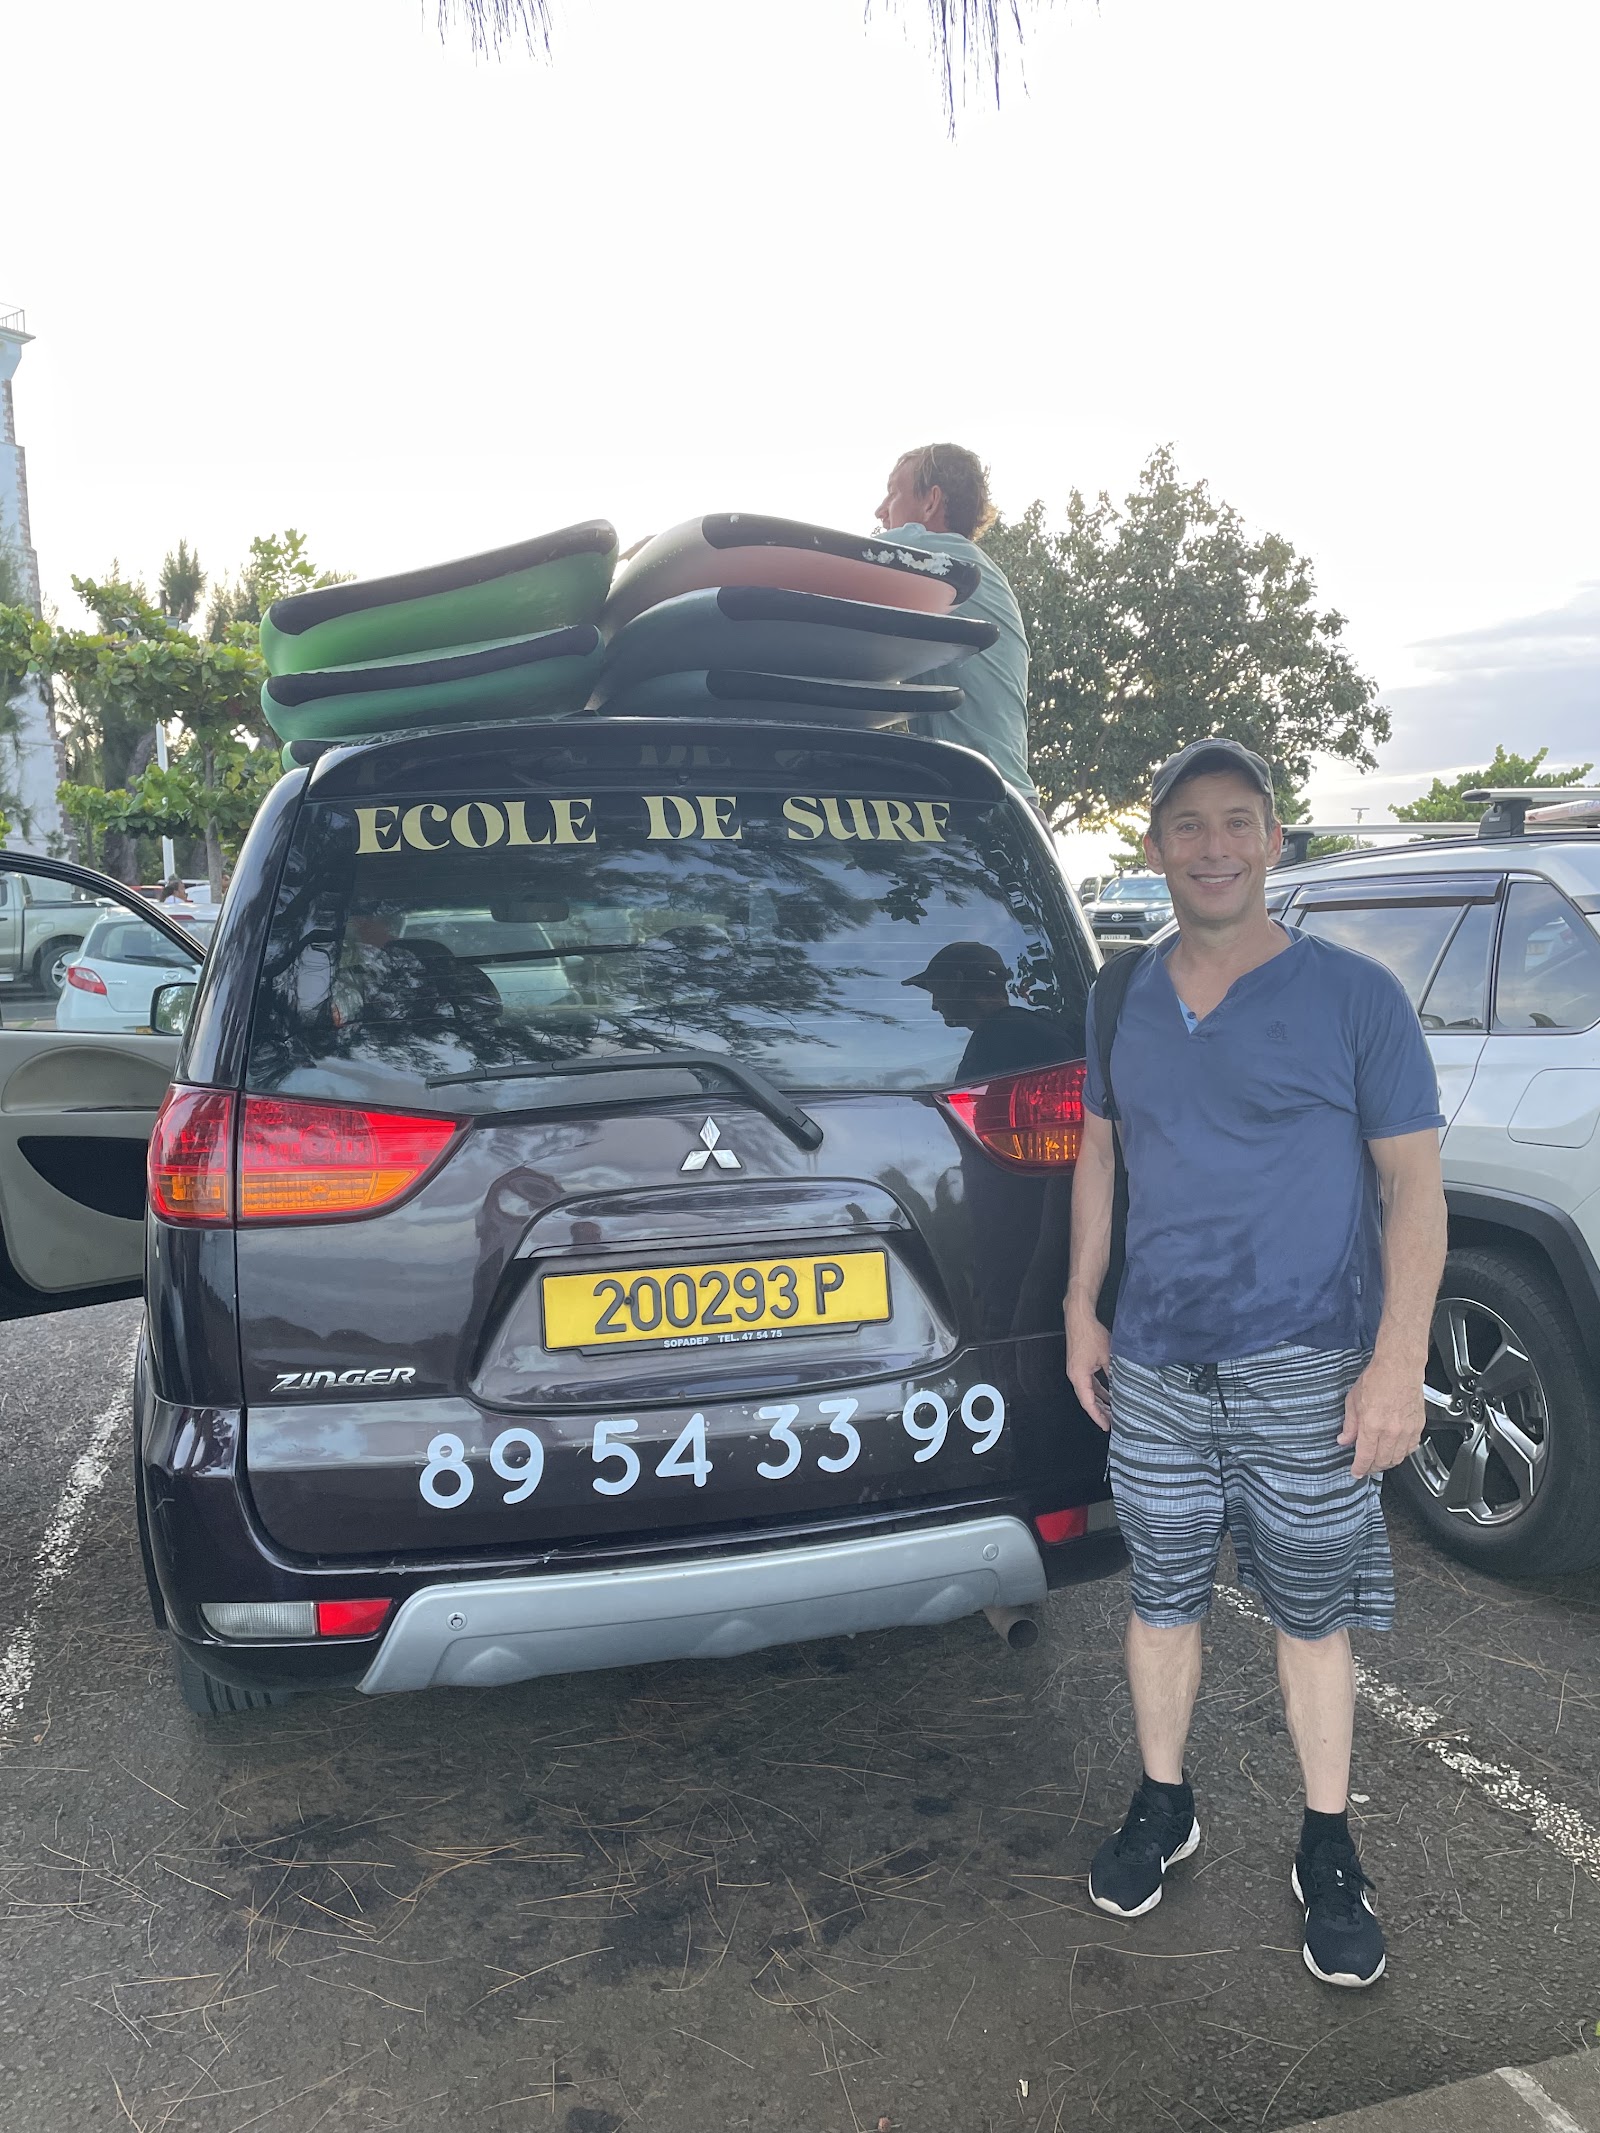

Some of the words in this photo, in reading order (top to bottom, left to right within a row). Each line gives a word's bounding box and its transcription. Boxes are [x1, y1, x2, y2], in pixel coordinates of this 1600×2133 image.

[354, 798, 596, 855] ECOLE
[643, 796, 743, 840] DE
[782, 796, 951, 843] SURF
[592, 1265, 800, 1335] 200293
[813, 1262, 845, 1315] P
[663, 1336, 709, 1348] SOPADEP
[718, 1334, 740, 1343] TEL.
[741, 1331, 753, 1341] 47
[757, 1330, 769, 1339] 54
[770, 1329, 783, 1338] 75
[270, 1367, 416, 1392] ZINGER
[419, 1428, 545, 1509] 89
[592, 1412, 713, 1496] 54
[756, 1398, 861, 1480] 33
[902, 1383, 1006, 1463] 99
